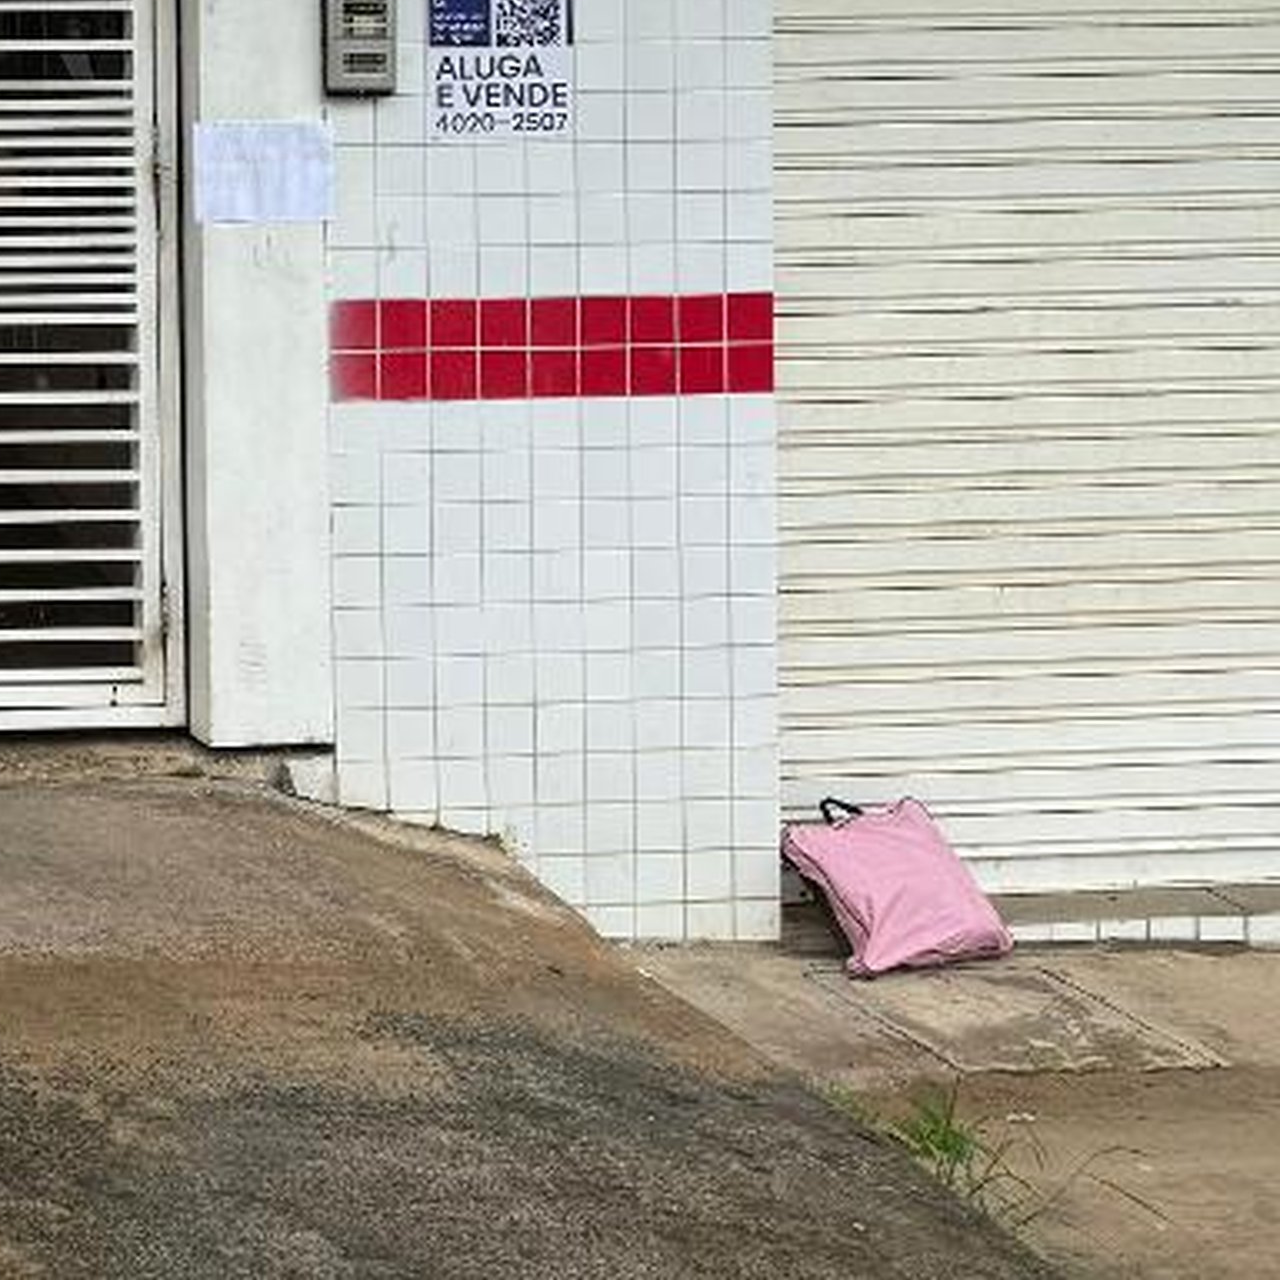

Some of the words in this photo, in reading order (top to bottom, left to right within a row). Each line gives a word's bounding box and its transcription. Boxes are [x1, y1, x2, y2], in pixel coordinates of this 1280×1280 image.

[436, 55, 544, 81] ALUGA
[437, 83, 454, 108] E
[461, 83, 567, 108] VENDE
[436, 112, 568, 134] 4020-2507
